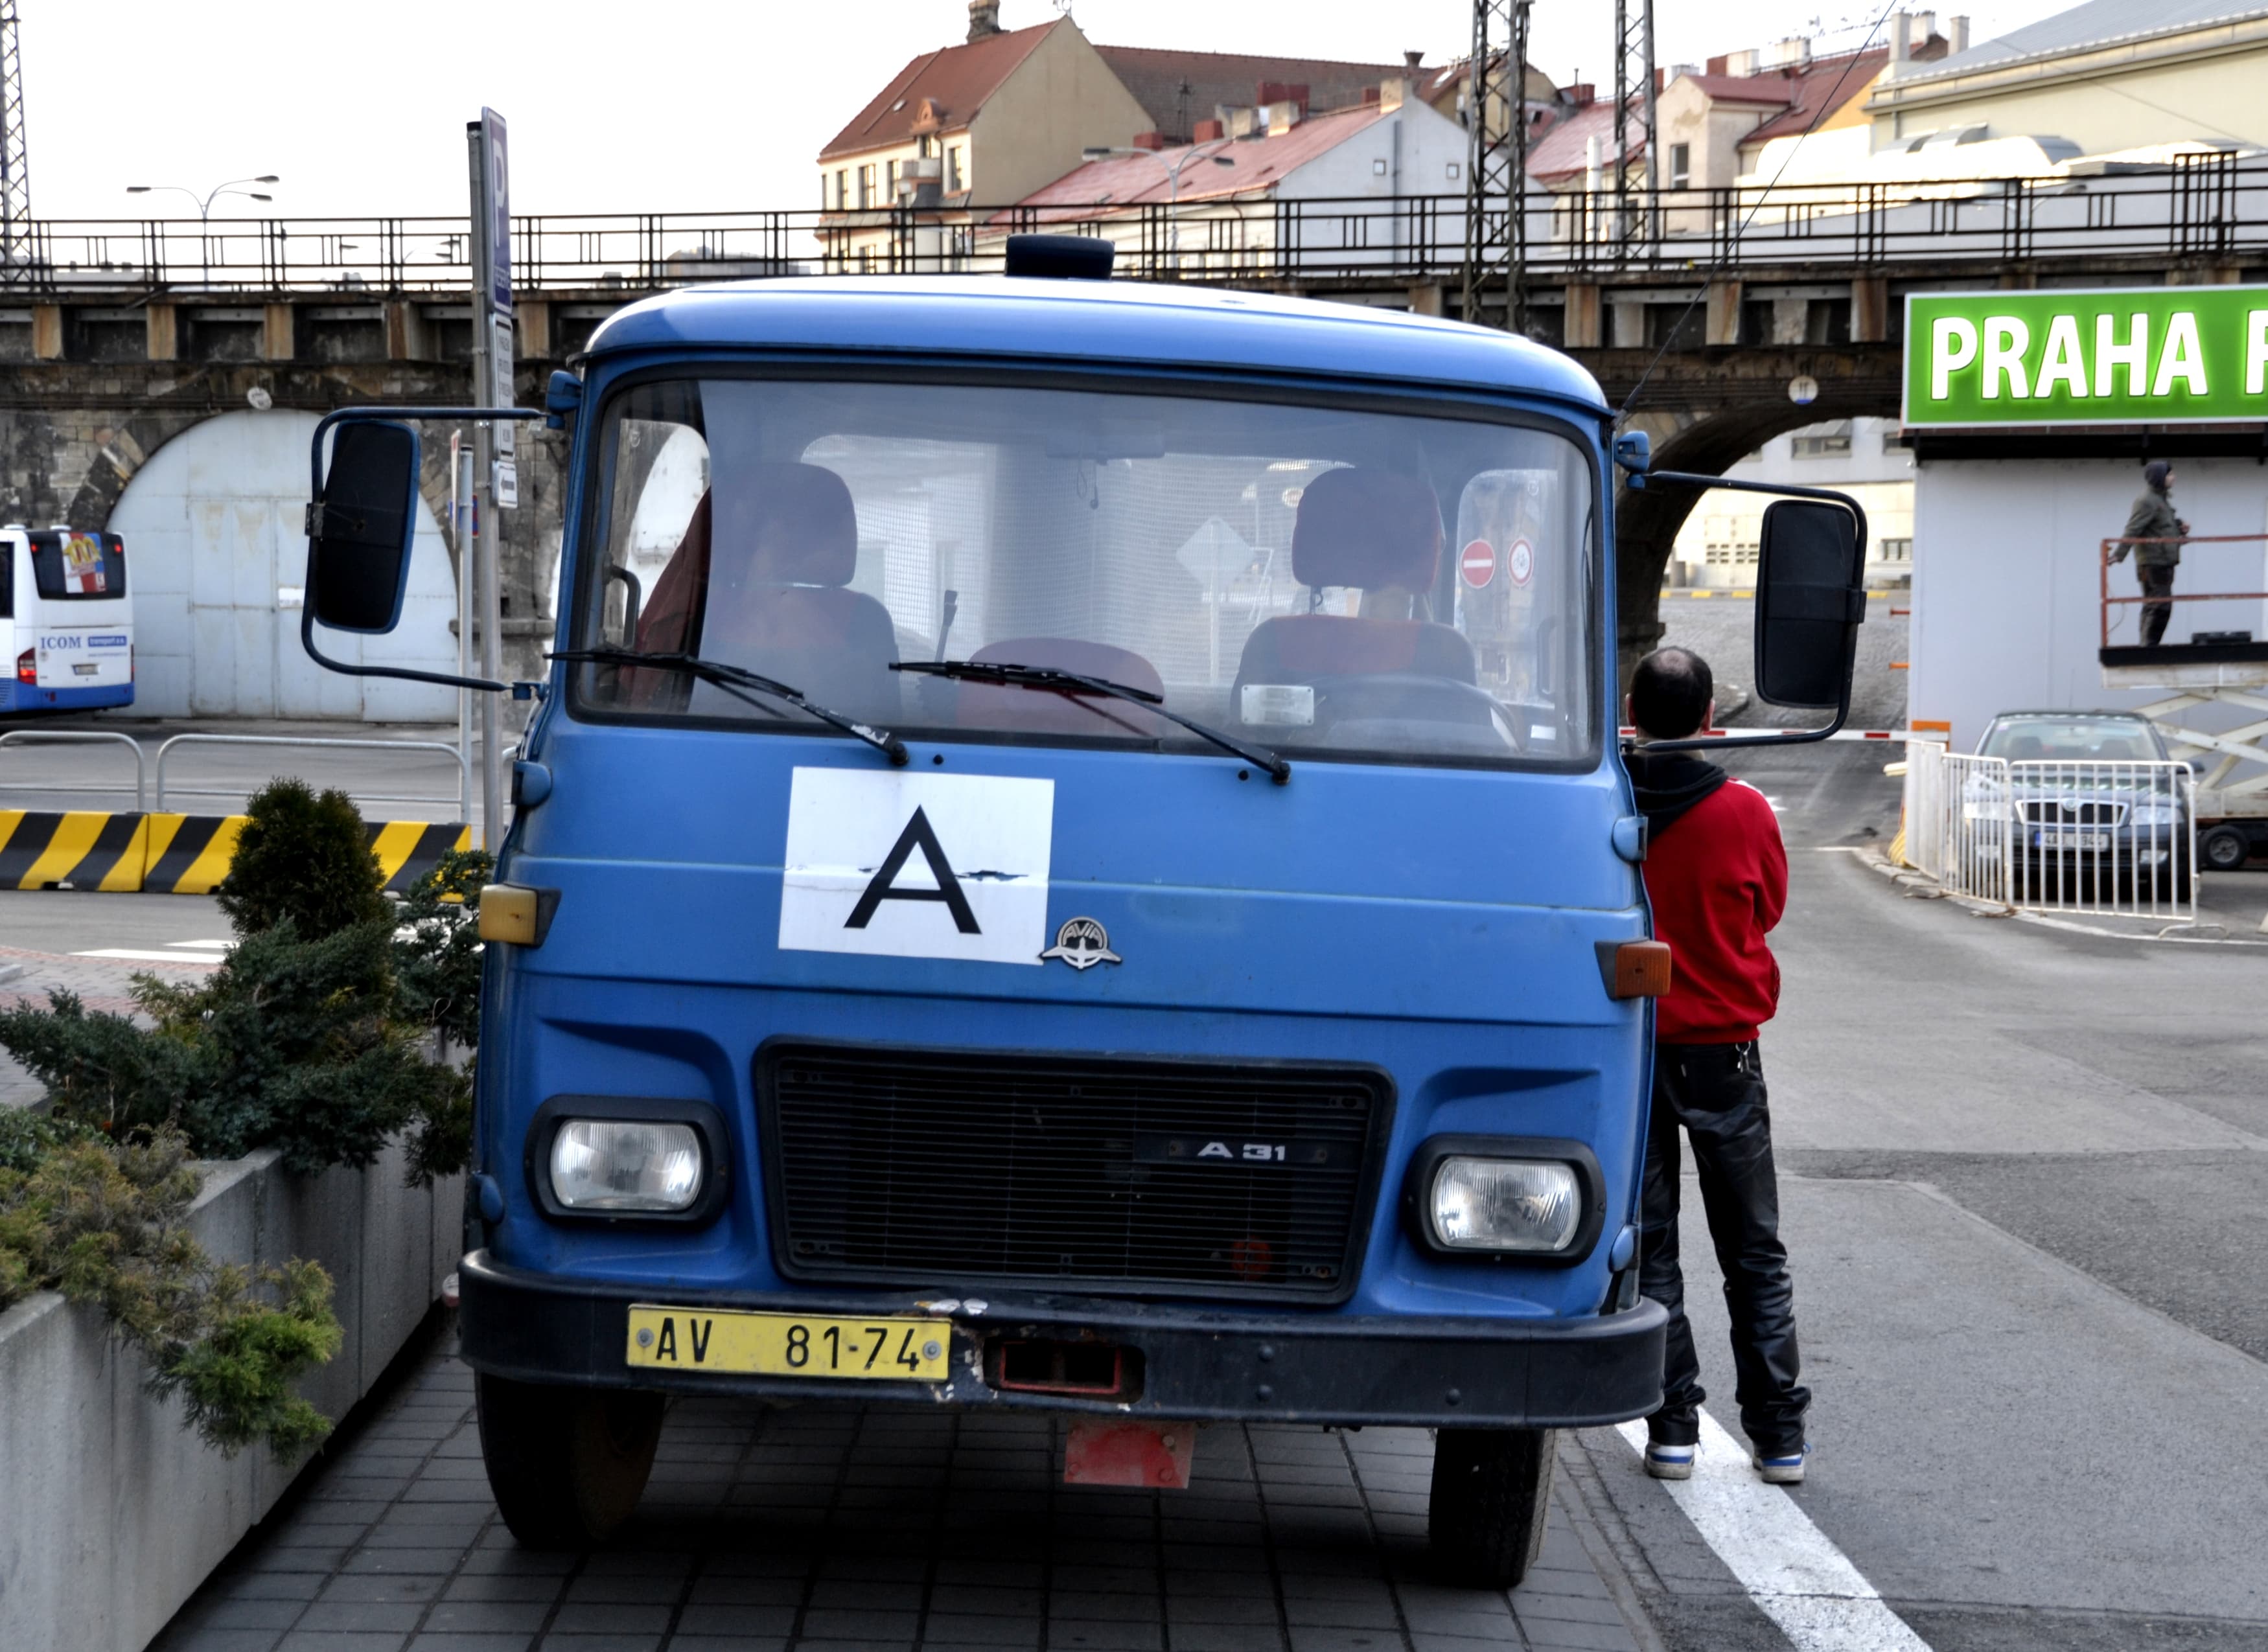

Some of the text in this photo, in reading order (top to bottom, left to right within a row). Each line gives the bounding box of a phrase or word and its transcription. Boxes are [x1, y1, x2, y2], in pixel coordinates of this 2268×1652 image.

[493, 138, 505, 247] P
[1931, 311, 2209, 400] PRAHA
[40, 636, 81, 649] ICOM
[844, 804, 982, 935] A
[1063, 923, 1102, 948] AVIA
[1197, 1141, 1286, 1161] A 31
[655, 1317, 920, 1371] AV 81-74
